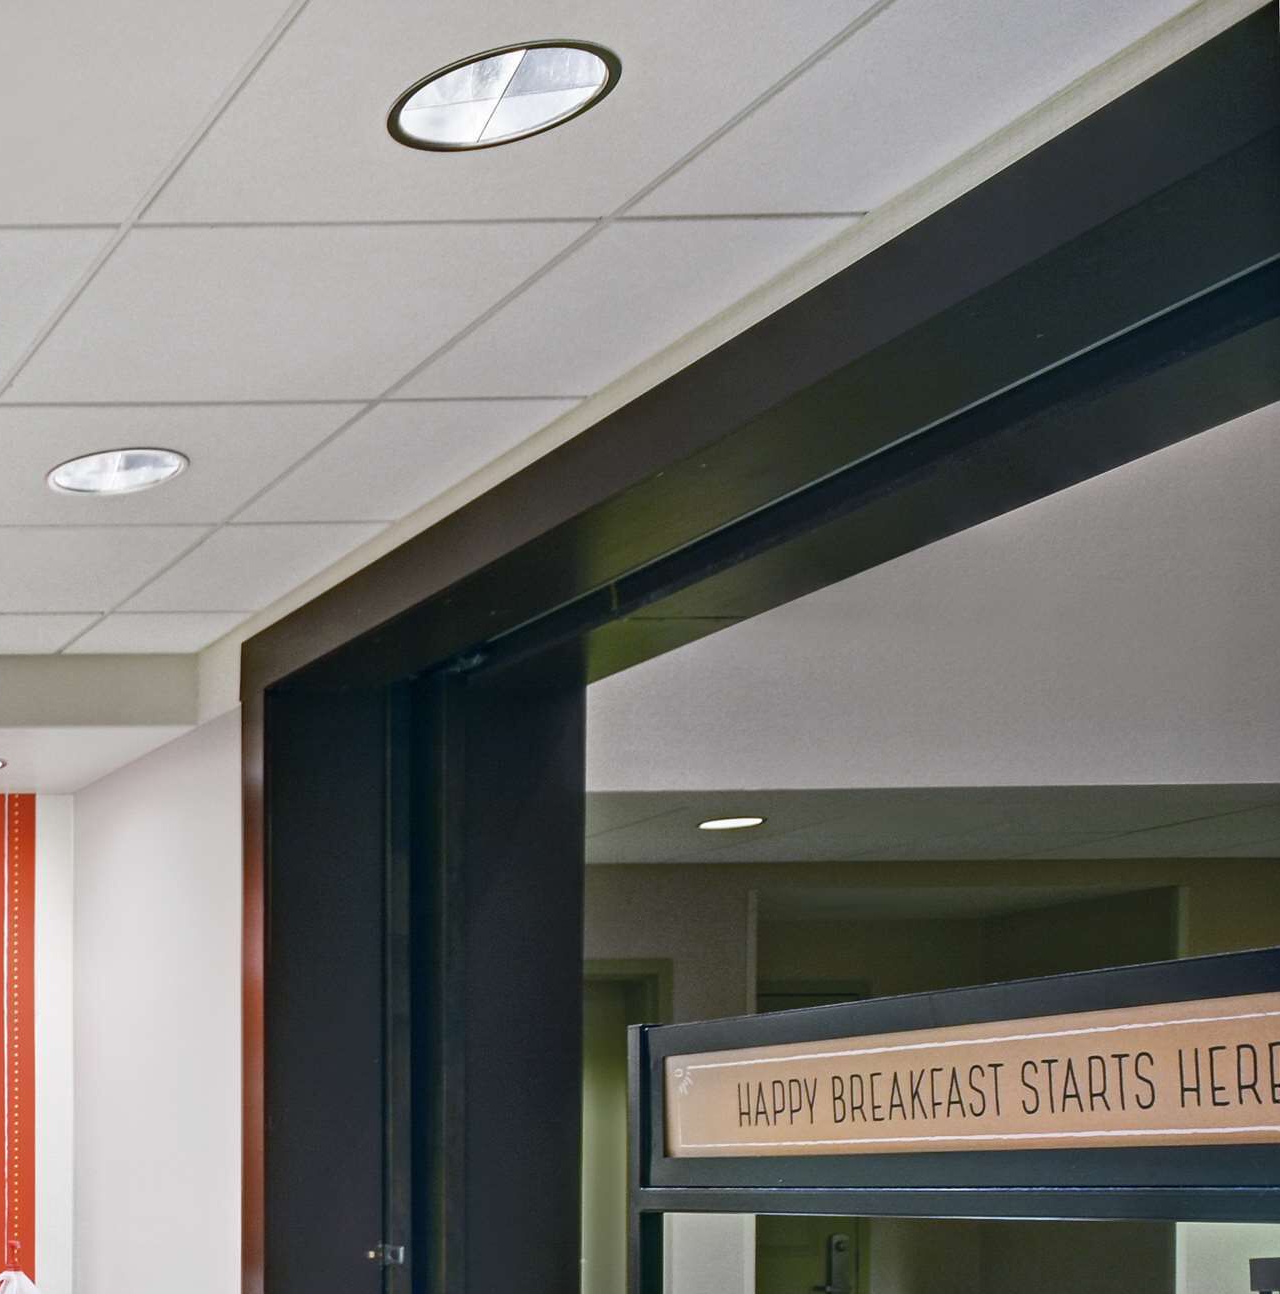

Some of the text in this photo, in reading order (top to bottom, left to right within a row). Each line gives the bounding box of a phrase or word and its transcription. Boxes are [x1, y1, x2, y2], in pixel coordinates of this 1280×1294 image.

[737, 1077, 817, 1127] HAPPY
[831, 1063, 1004, 1124] BREAKFAST
[1021, 1052, 1156, 1115] STARTS
